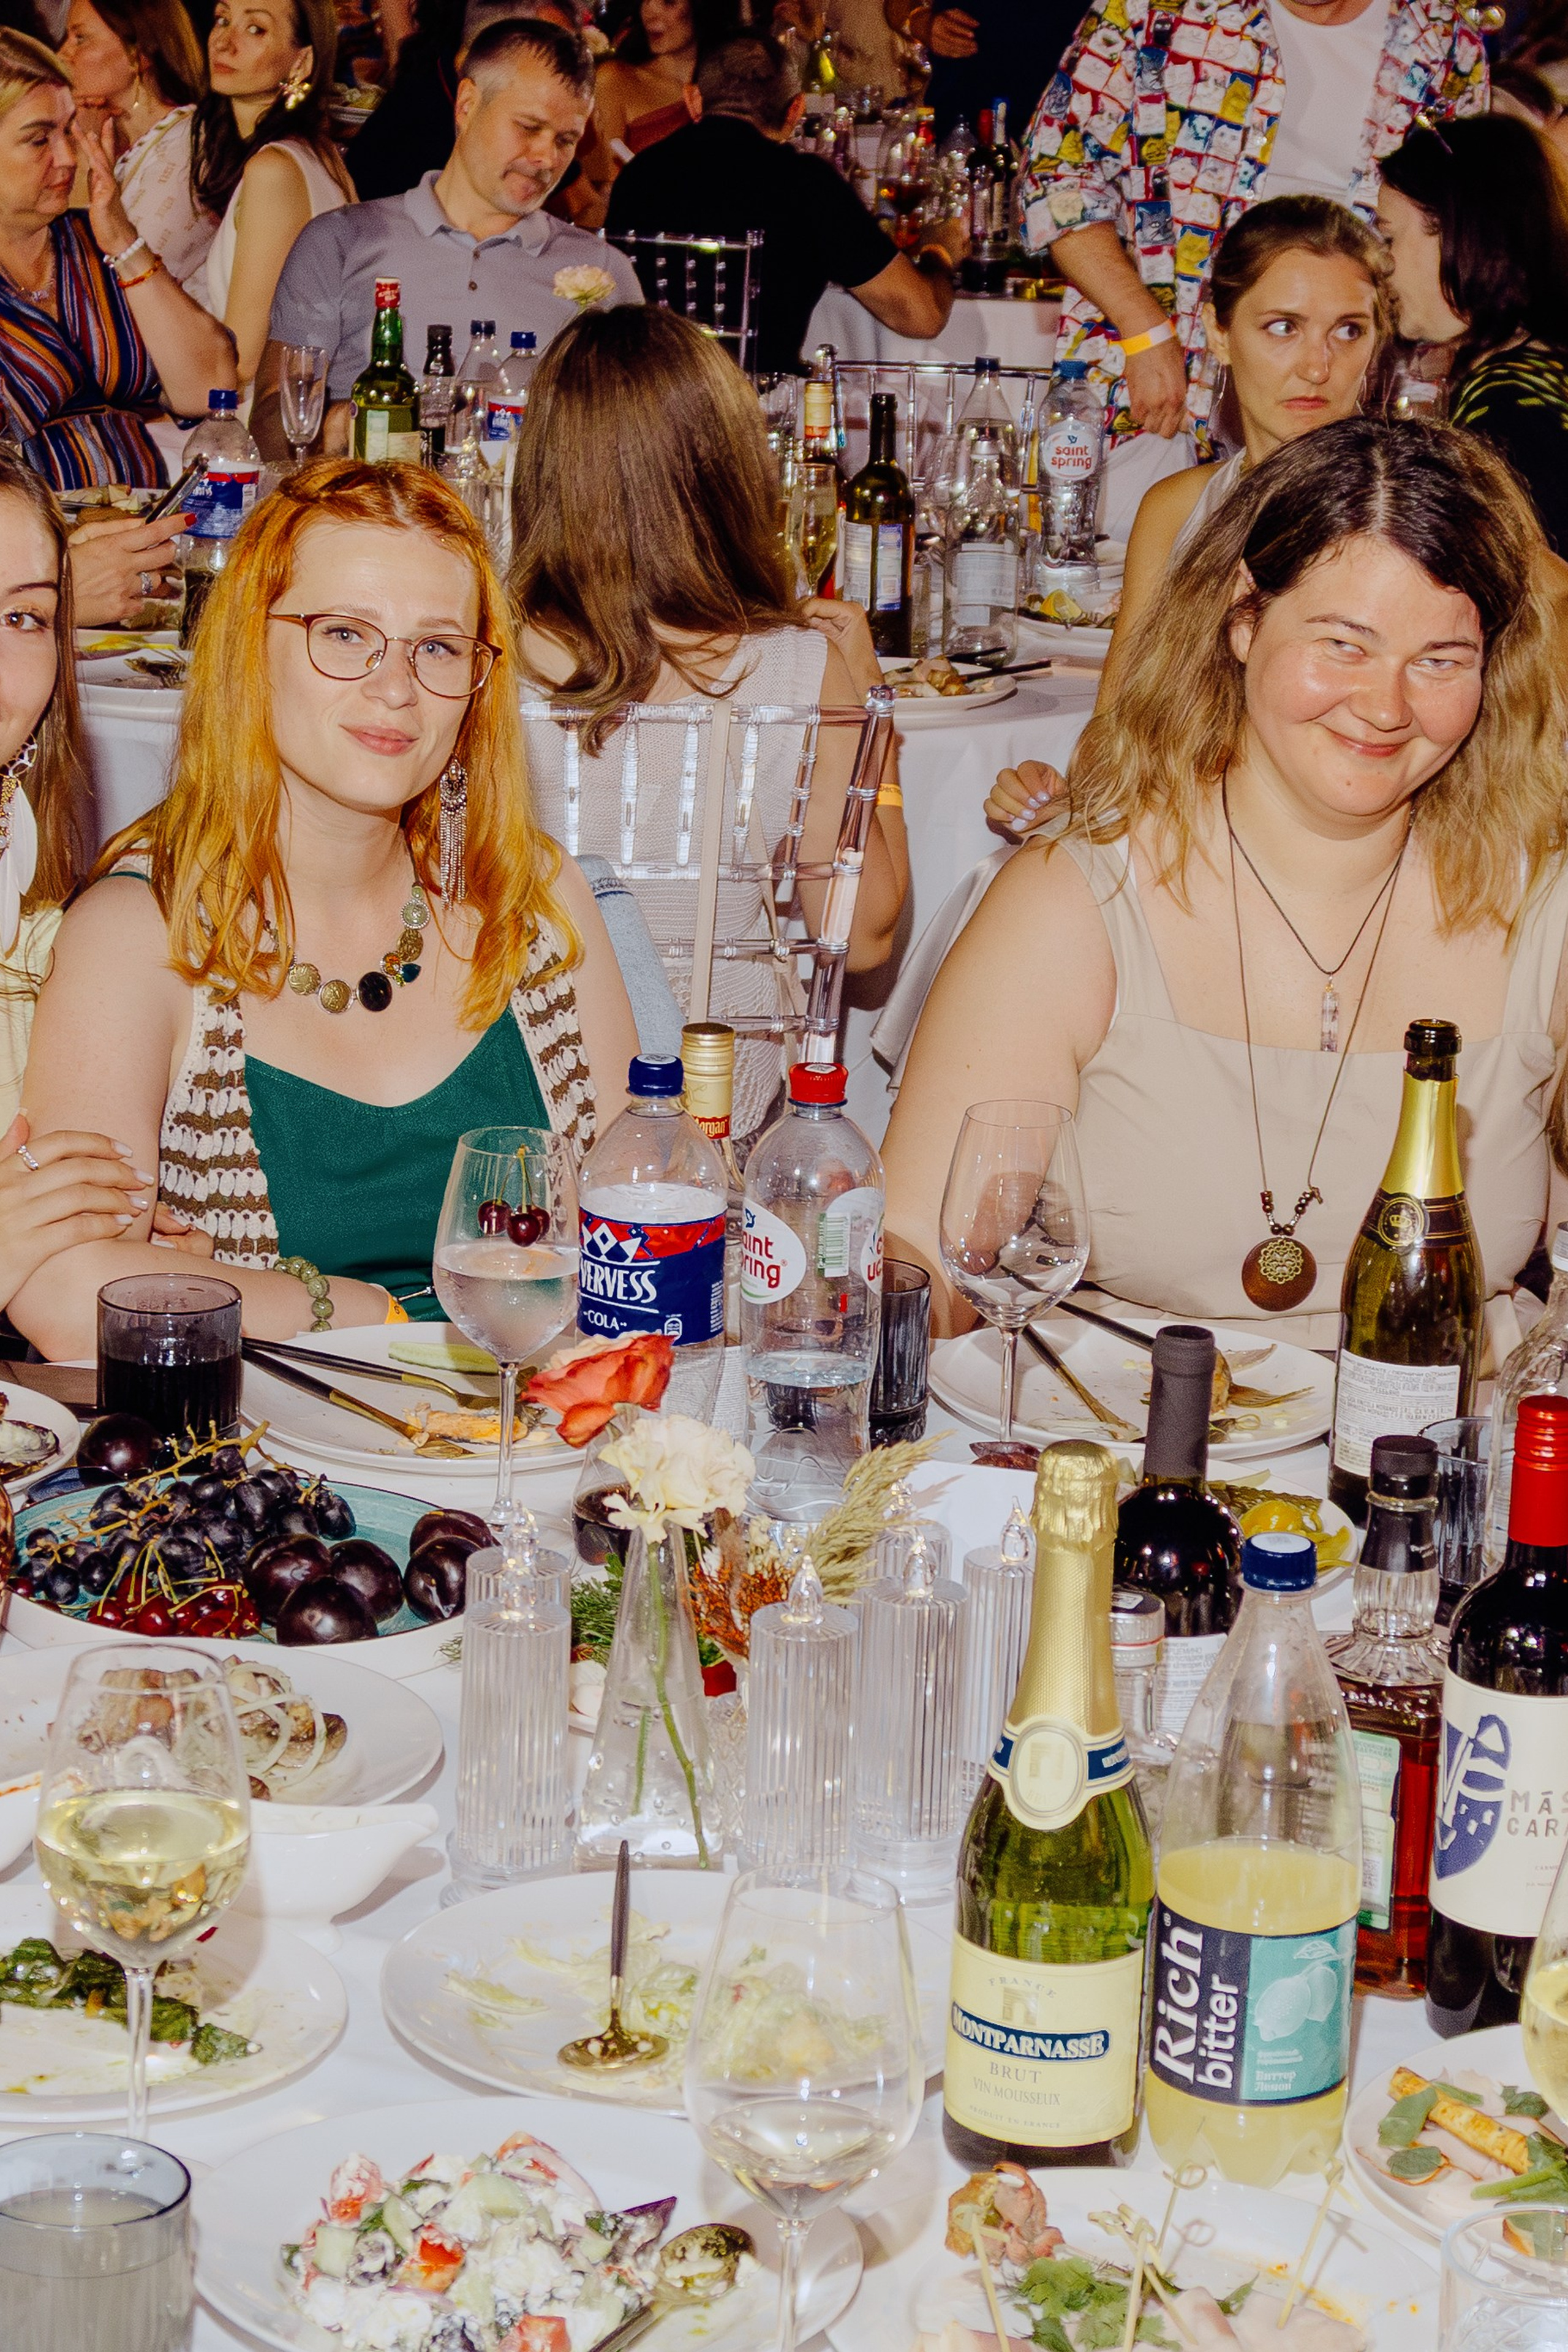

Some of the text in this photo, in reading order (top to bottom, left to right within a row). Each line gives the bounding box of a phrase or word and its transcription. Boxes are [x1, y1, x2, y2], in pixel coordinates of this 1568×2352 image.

[1055, 445, 1088, 455] saint
[1051, 456, 1092, 470] spring
[695, 1118, 725, 1137] organ
[742, 1231, 774, 1259] aint
[579, 1255, 657, 1303] VERVESS
[741, 1254, 781, 1289] ring
[587, 1310, 619, 1330] COLA
[1507, 1817, 1568, 1837] CAR
[989, 1976, 1057, 1999] FRANCE
[1153, 1926, 1203, 2084] Rich
[953, 2006, 1104, 2059] MONTPARNASSE
[1196, 1973, 1239, 2089] bitter
[990, 2061, 1042, 2084] BRUT
[973, 2076, 1061, 2106] VIN MOUSSEUX
